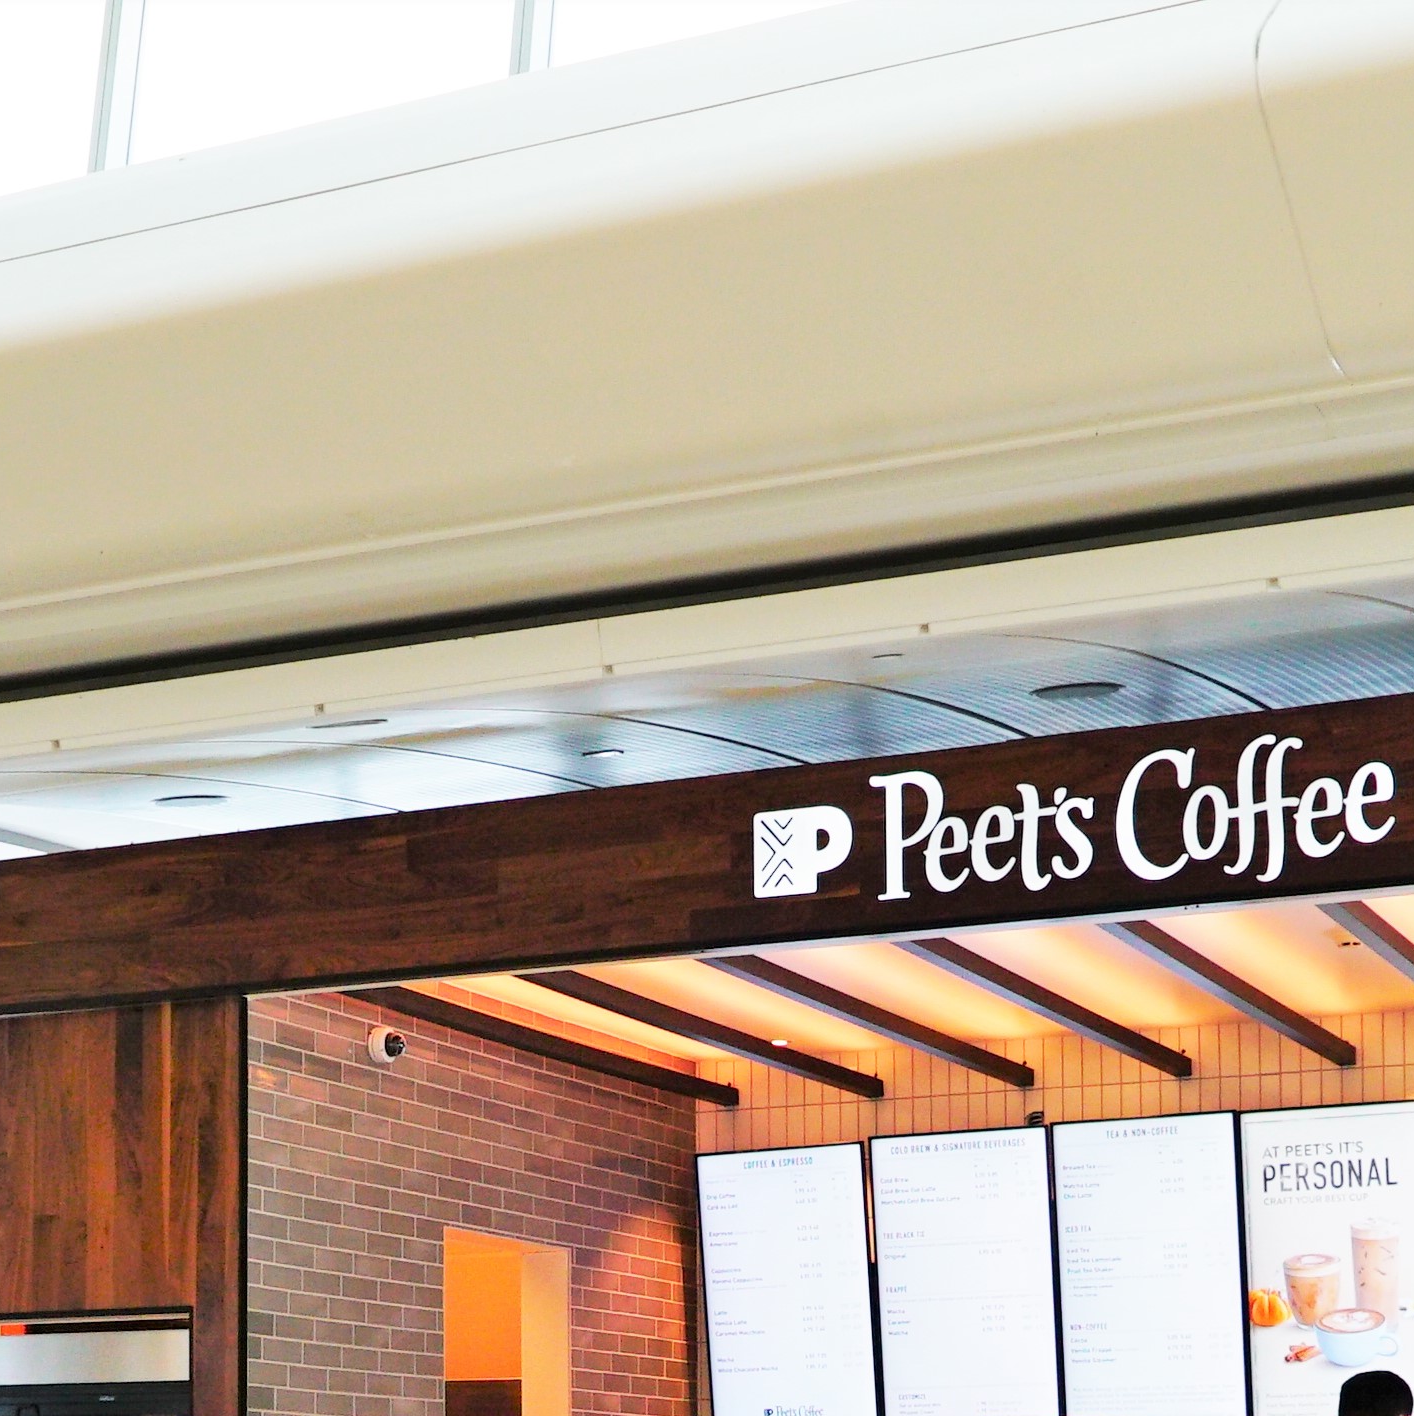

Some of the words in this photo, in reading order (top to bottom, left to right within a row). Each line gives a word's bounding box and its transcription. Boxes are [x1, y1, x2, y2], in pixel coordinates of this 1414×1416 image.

[868, 769, 1096, 901] Peet's
[1115, 733, 1397, 884] Coffee
[1106, 1130, 1120, 1139] TEA
[1122, 1129, 1128, 1138] &
[1131, 1126, 1178, 1137] NON-COFFEE
[890, 1146, 908, 1155] COLD
[910, 1144, 931, 1154] BREW
[933, 1144, 939, 1152] &
[941, 1140, 981, 1152] SIGNATURE
[984, 1137, 1026, 1149] BEVERAGES
[1262, 1145, 1279, 1159] AT
[1285, 1142, 1334, 1158] PEET'S
[1339, 1140, 1364, 1154] IT'S
[743, 1160, 768, 1170] COFFEE
[770, 1159, 776, 1168] &
[778, 1156, 813, 1168] ESPRESSO
[1262, 1157, 1398, 1193] PERSONAL
[1263, 1196, 1293, 1206] CRAFT
[1295, 1195, 1323, 1204] YOUR
[1324, 1194, 1347, 1202] BEST
[1349, 1192, 1369, 1201] CUP
[896, 1231, 914, 1239] BLACK
[1065, 1225, 1078, 1233] ICED
